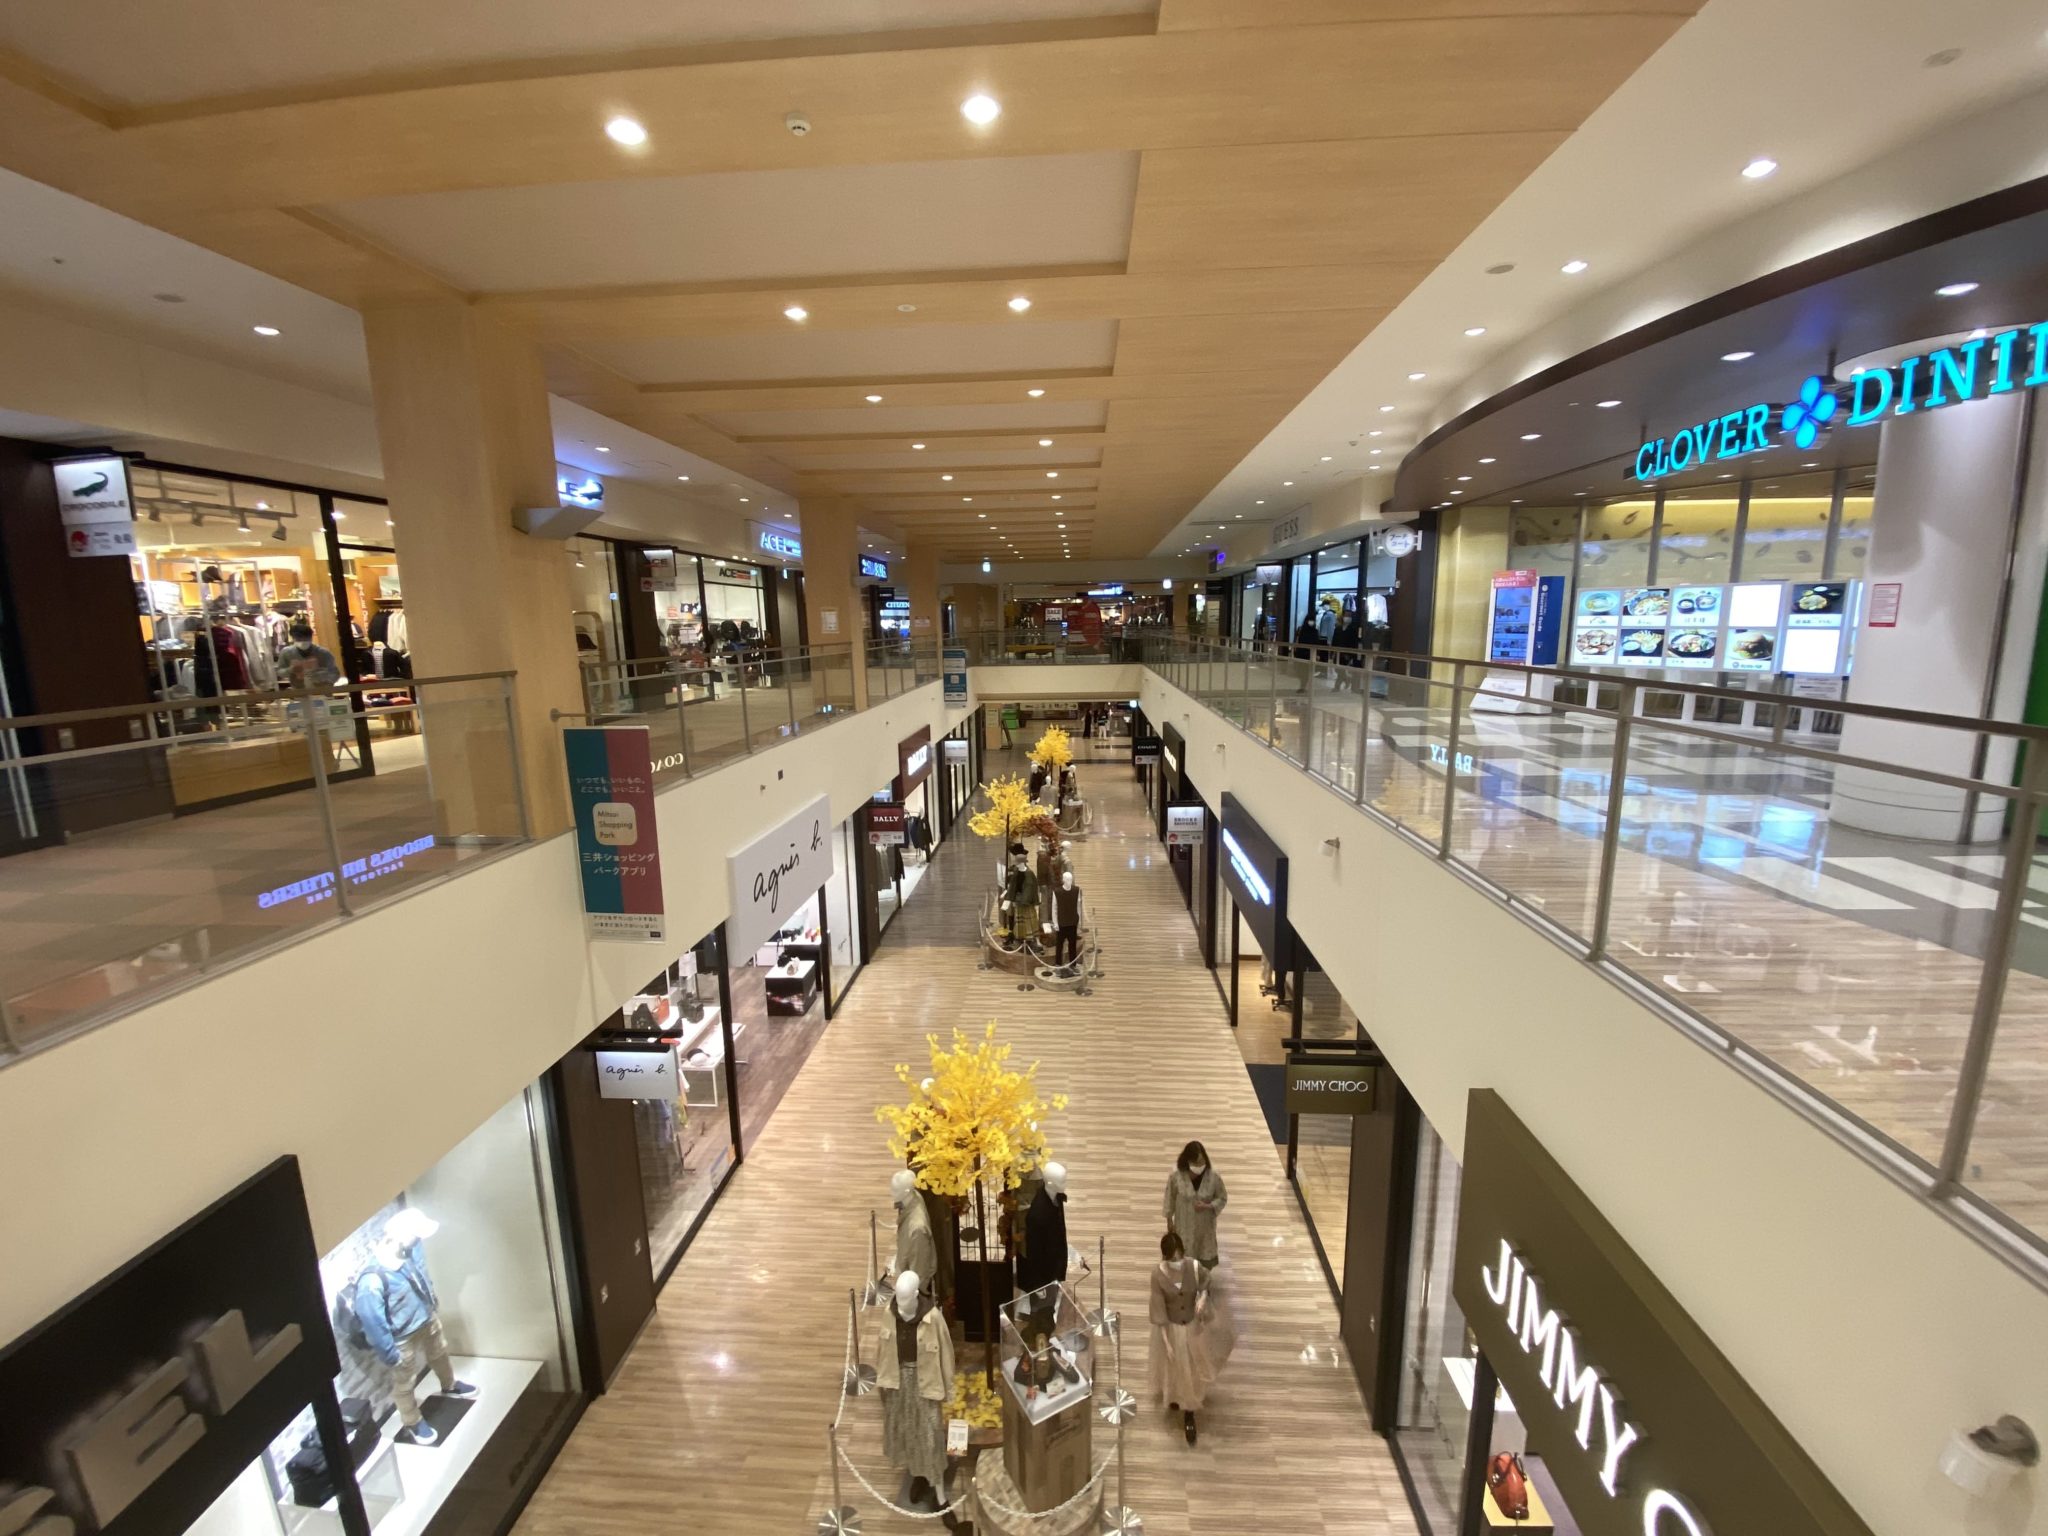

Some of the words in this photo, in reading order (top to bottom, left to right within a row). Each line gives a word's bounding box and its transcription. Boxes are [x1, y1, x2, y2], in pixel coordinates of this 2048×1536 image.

[1635, 402, 1769, 481] CLOVER
[62, 500, 126, 512] CROCODILE
[1273, 516, 1299, 544] GUESS
[760, 531, 784, 552] ACE
[719, 567, 737, 578] ACE
[598, 820, 633, 830] Shopping
[600, 831, 615, 839] Park
[582, 852, 656, 862] 三井ショッピング
[593, 866, 647, 876] パークアプリ
[1292, 1080, 1326, 1091] JIMMY
[1328, 1080, 1369, 1092] CHOO
[1482, 1237, 1638, 1498] JIMMY
